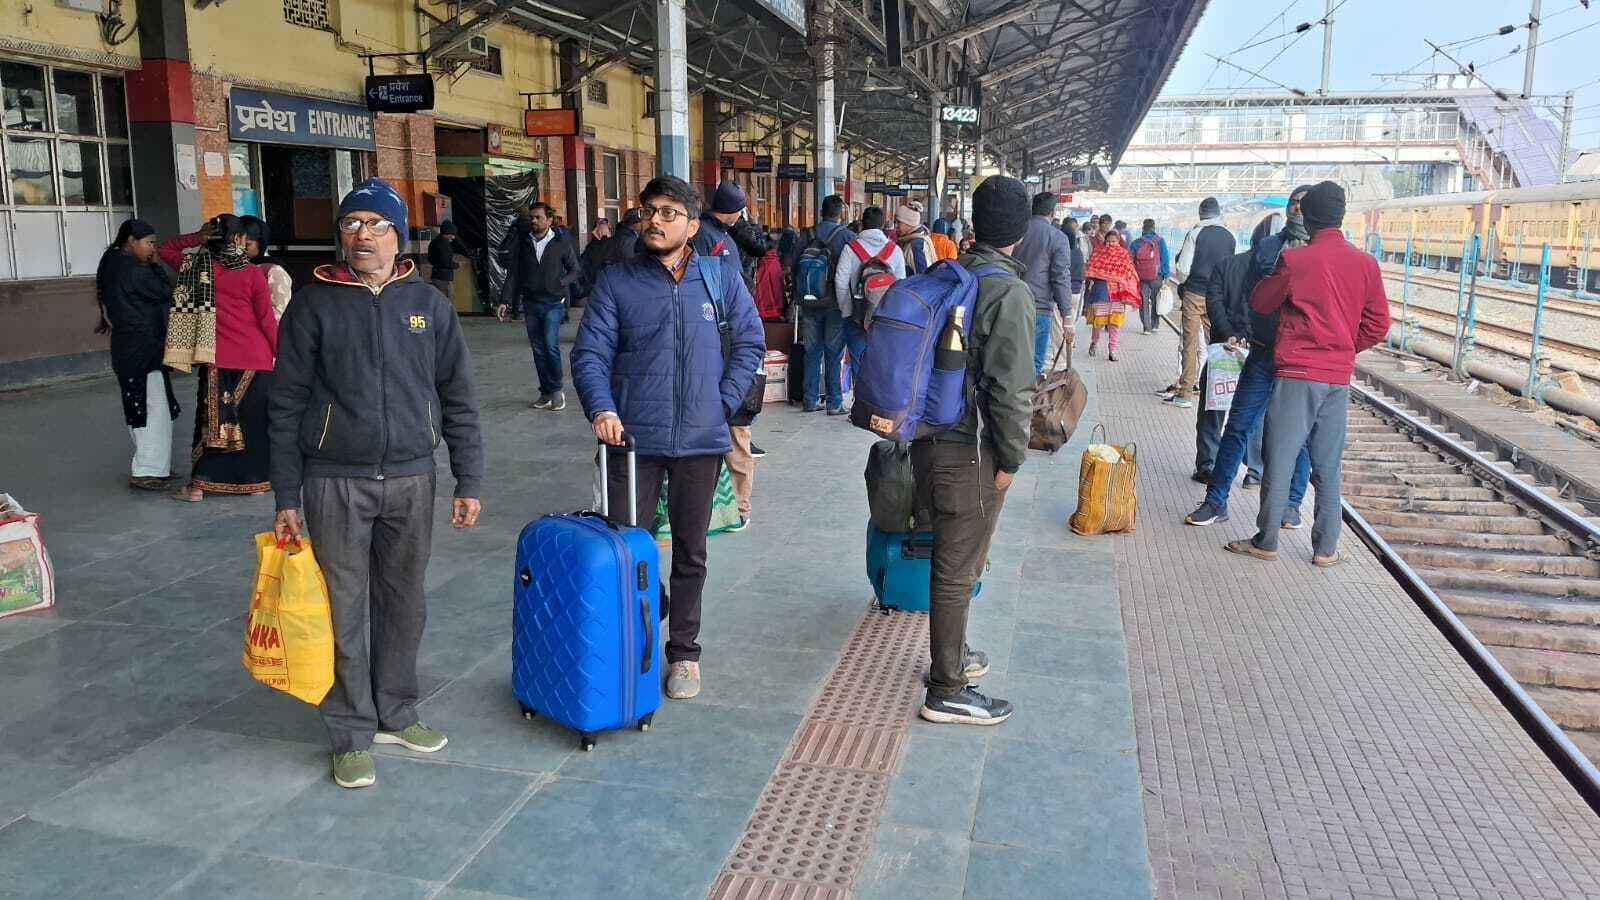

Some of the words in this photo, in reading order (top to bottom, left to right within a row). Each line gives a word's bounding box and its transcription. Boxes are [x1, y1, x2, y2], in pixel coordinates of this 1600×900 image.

[389, 94, 424, 103] Entrance
[235, 99, 296, 133] प्रवेश
[308, 109, 371, 140] ENTRANCE
[943, 106, 978, 122] 13423
[410, 315, 426, 329] 95
[249, 623, 280, 650] NKA
